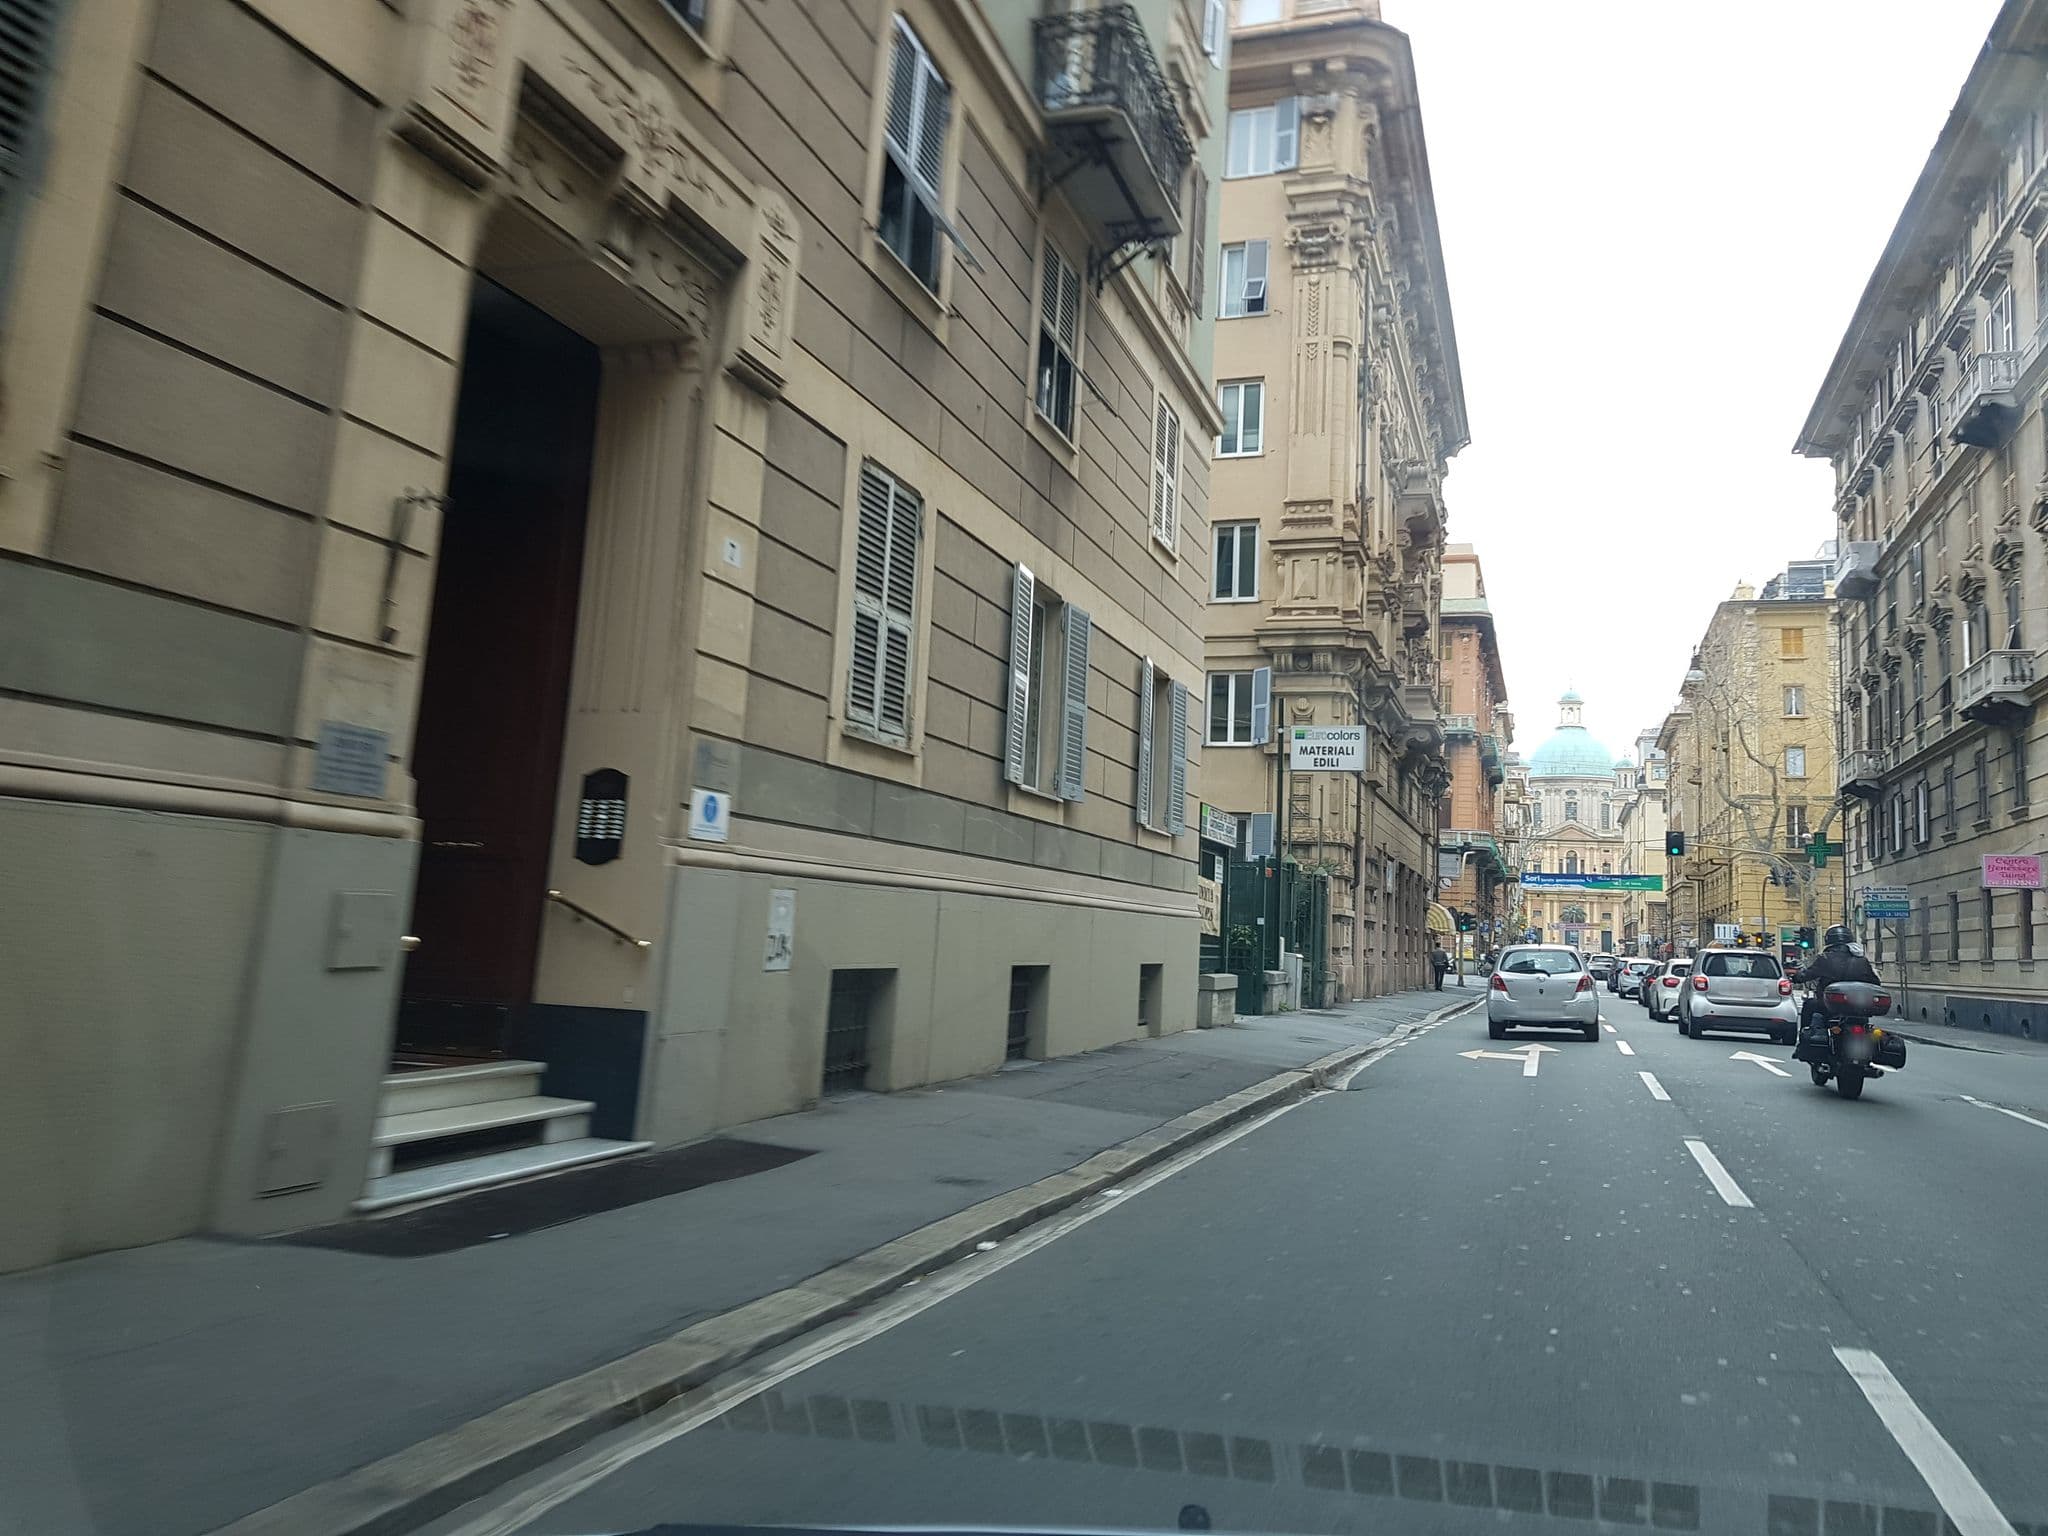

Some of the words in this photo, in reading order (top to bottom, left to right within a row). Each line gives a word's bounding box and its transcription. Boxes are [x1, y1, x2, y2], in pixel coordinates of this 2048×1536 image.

[1299, 745, 1355, 756] MATERIALI
[1313, 757, 1339, 768] EDILI
[1995, 857, 2029, 865] Centro
